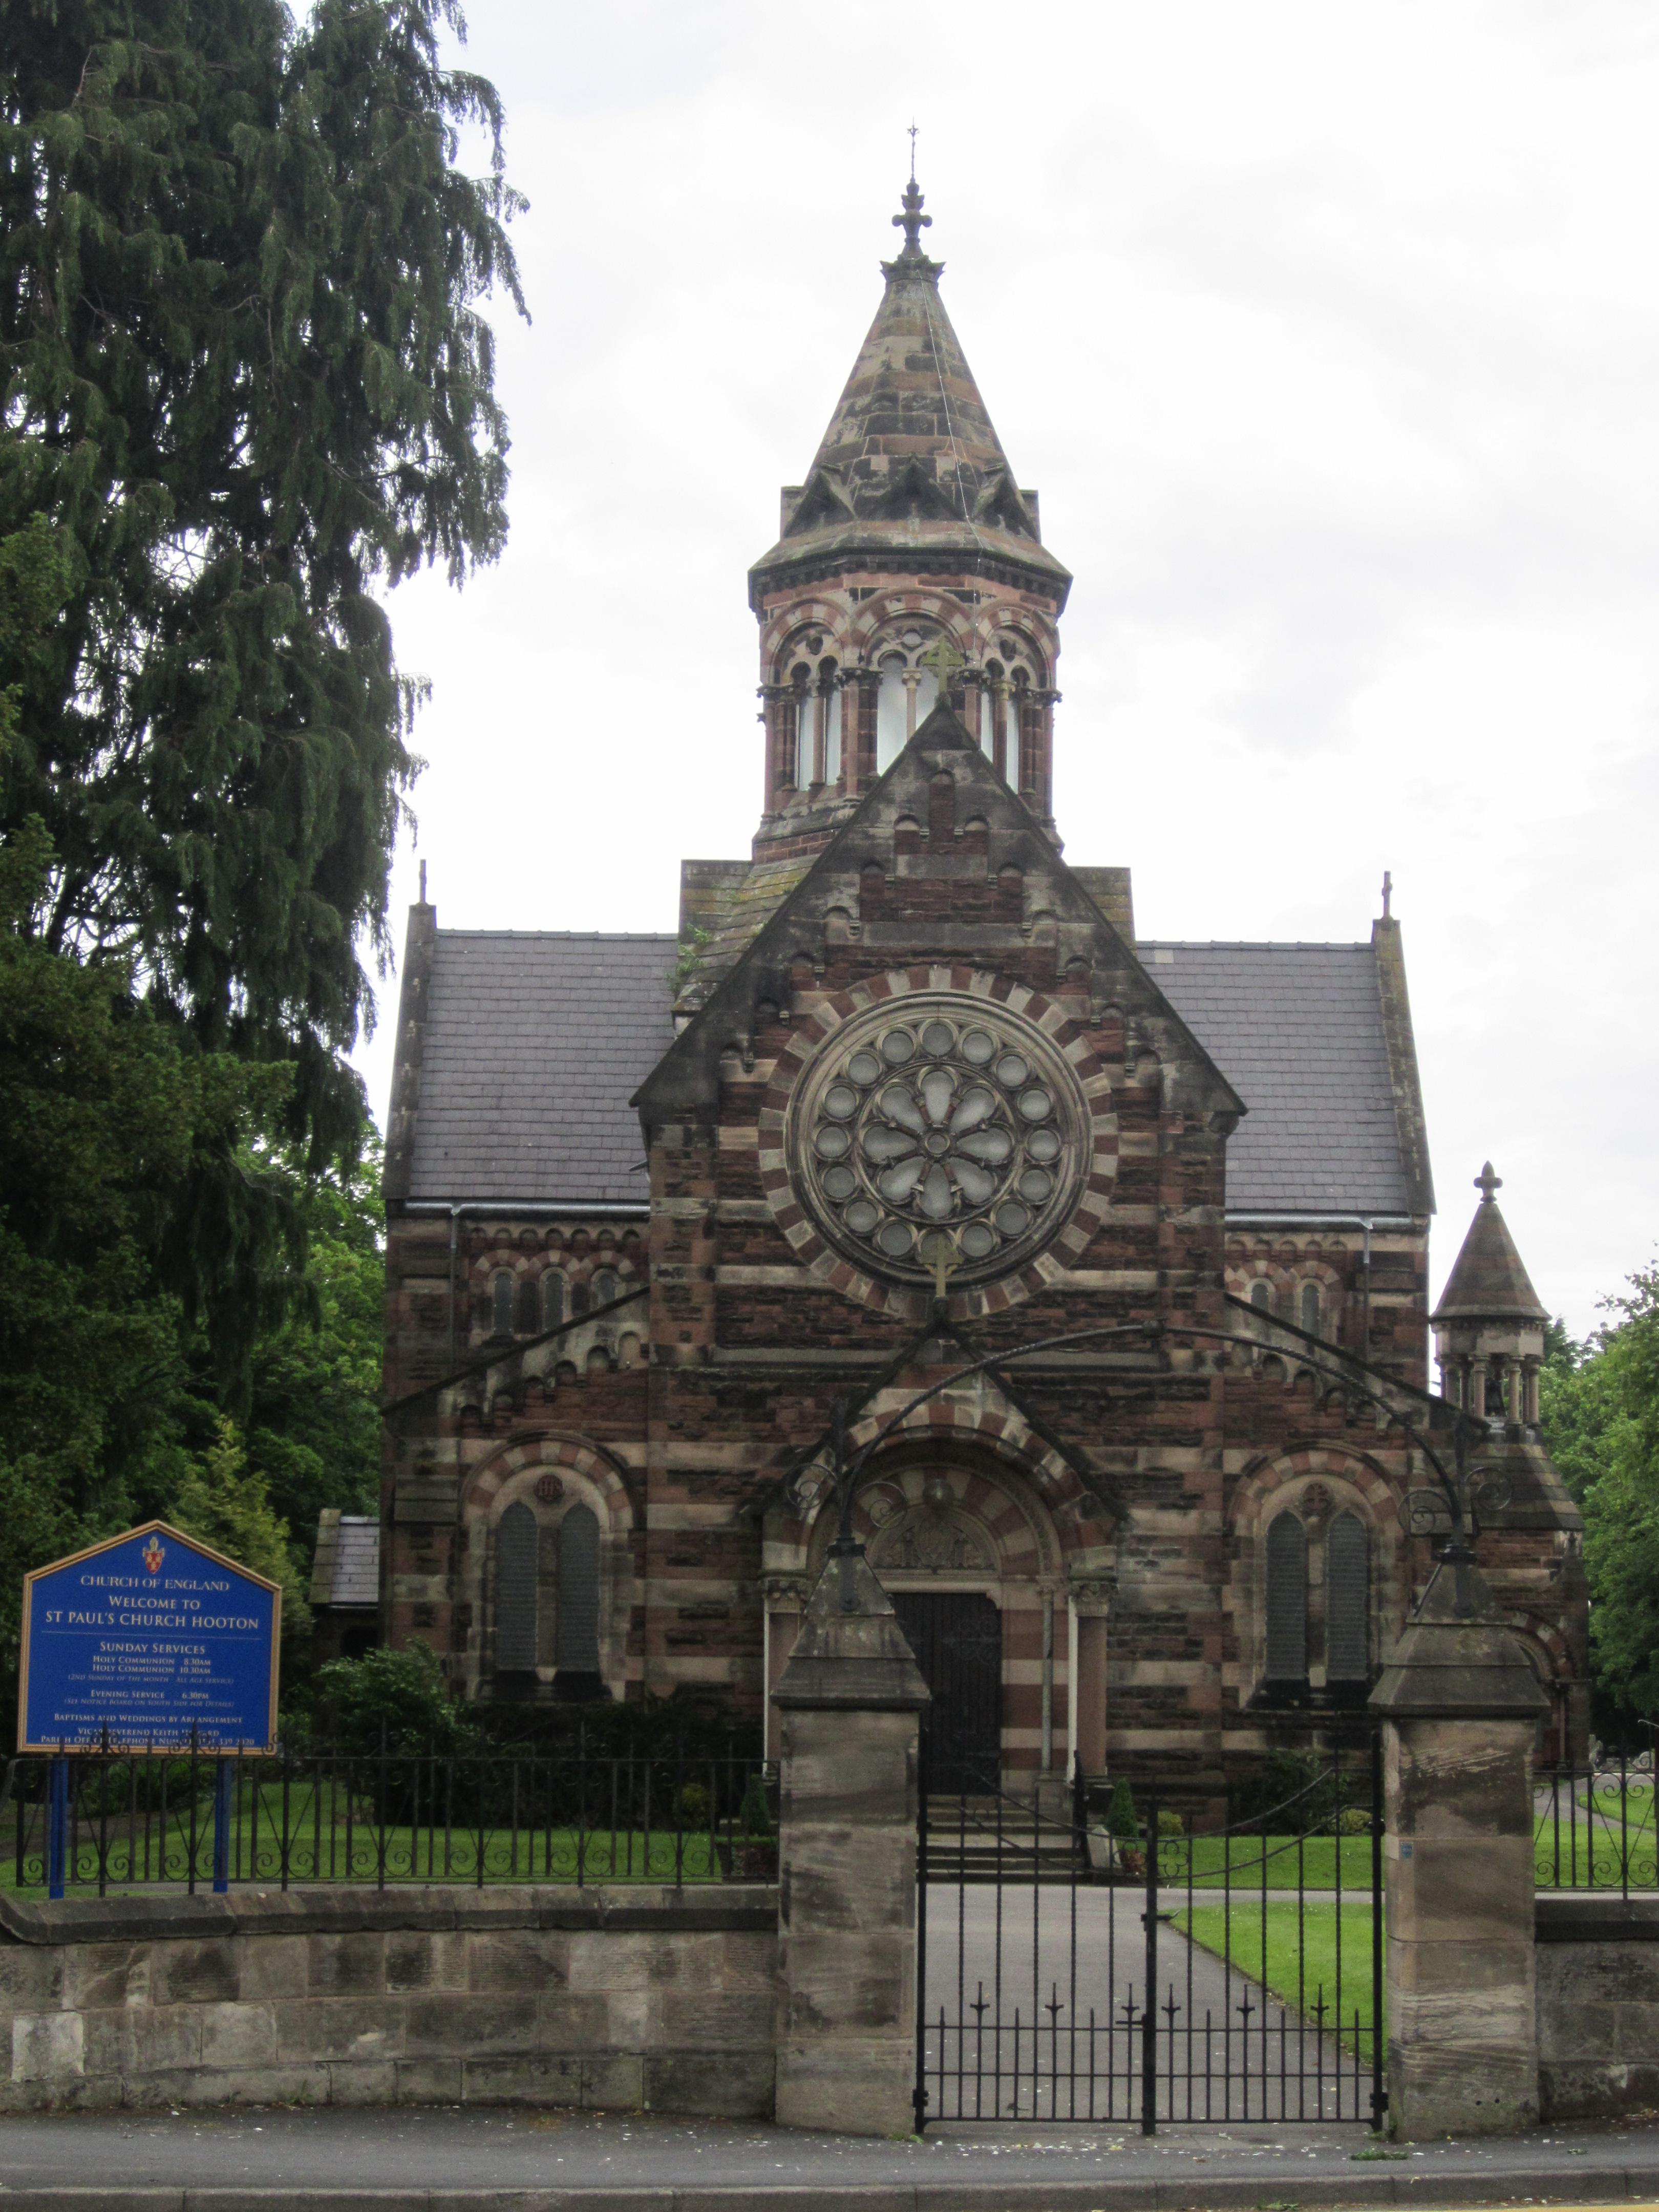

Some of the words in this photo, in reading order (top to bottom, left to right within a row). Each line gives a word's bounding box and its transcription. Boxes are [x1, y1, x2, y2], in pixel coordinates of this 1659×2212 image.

[81, 1575, 138, 1587] CHURCH
[142, 1578, 160, 1588] OF
[165, 1579, 229, 1591] ENGLAND
[109, 1596, 176, 1609] WELCOME
[182, 1600, 201, 1610] TO
[46, 1611, 62, 1623] ST
[69, 1612, 114, 1625] PAUL'S
[120, 1614, 185, 1627] CHURCH
[192, 1617, 258, 1629] HOOTON
[100, 1642, 147, 1652] SUNDAY
[153, 1643, 205, 1654] SERVICES
[91, 1690, 128, 1698] EVENING
[119, 1714, 165, 1722] WEDDINGS
